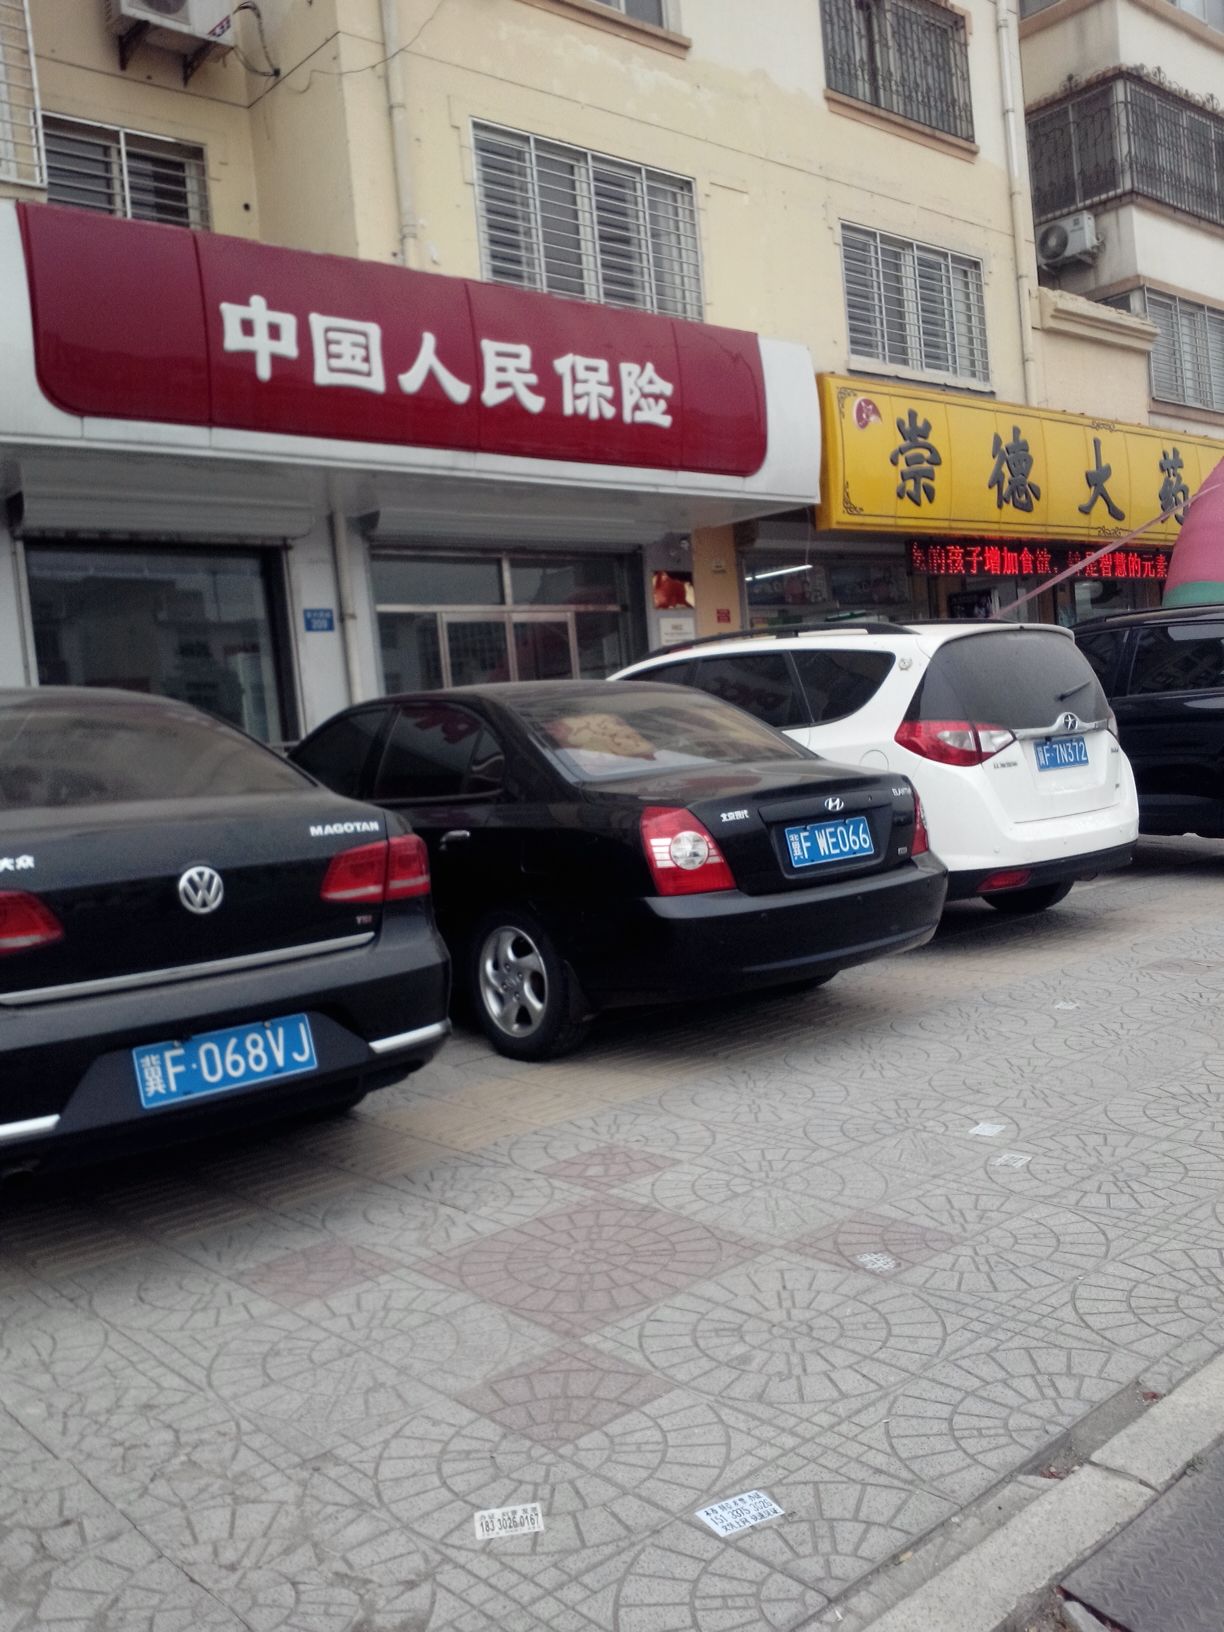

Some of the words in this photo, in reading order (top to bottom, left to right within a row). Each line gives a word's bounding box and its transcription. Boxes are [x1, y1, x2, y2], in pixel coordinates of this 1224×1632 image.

[219, 295, 673, 428] 中国人民保险
[309, 821, 379, 836] MAGOTAN
